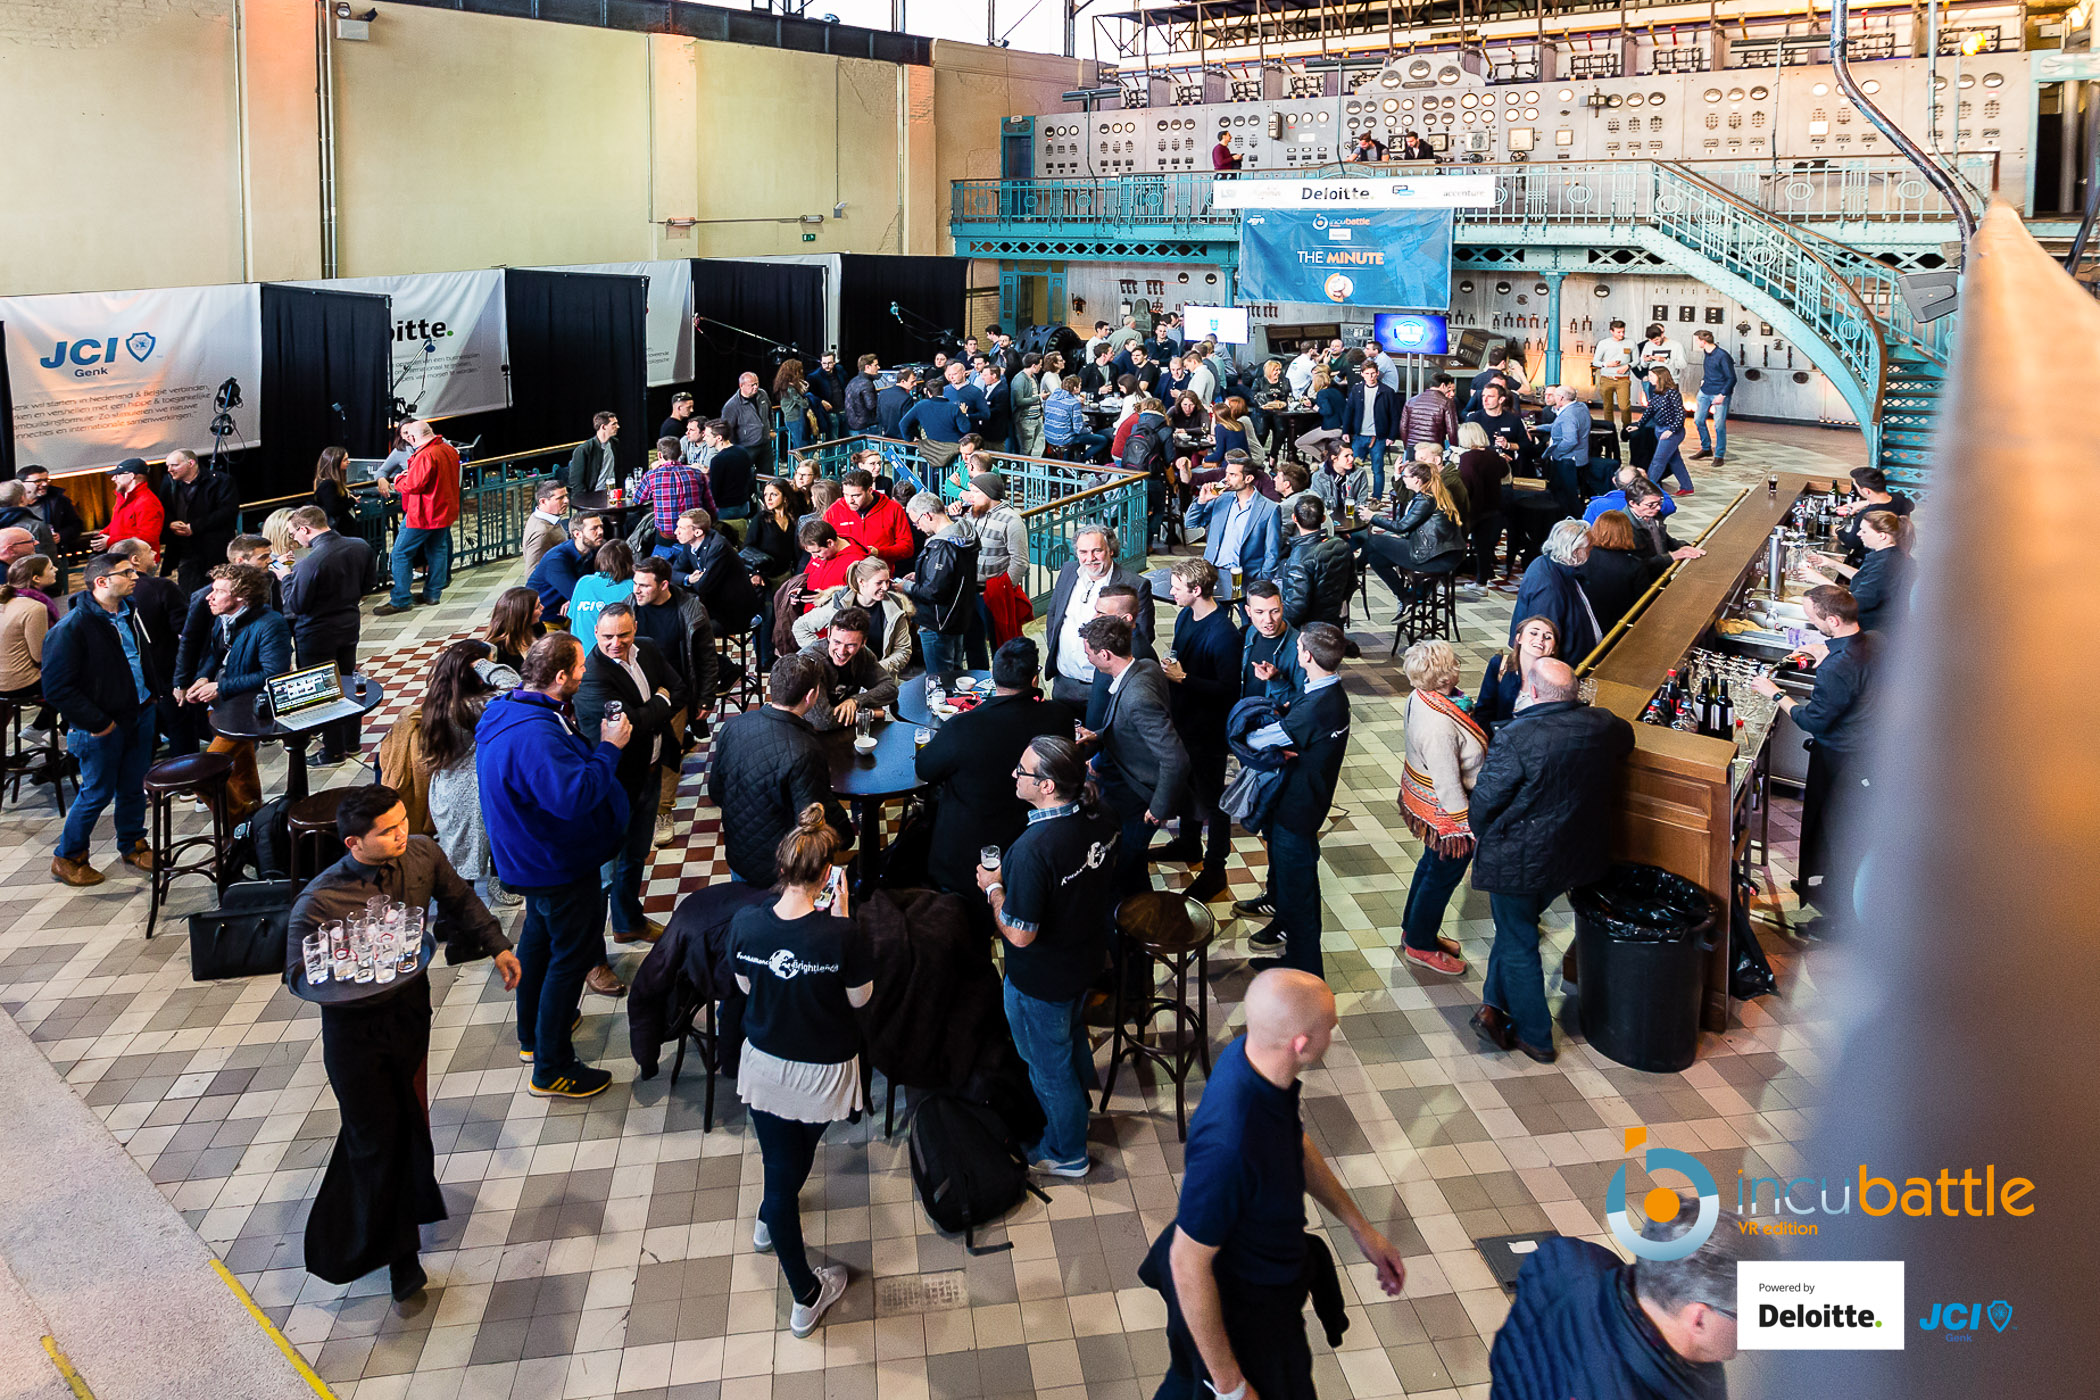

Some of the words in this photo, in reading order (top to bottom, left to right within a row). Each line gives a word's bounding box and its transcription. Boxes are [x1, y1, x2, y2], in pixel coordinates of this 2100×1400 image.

[1297, 250, 1323, 264] THE
[1326, 252, 1384, 265] MINUTE
[40, 337, 119, 369] JCI
[74, 367, 108, 377] Genk
[89, 392, 134, 403] Nederland
[170, 403, 198, 411] nieuwe
[69, 421, 126, 432] internationale
